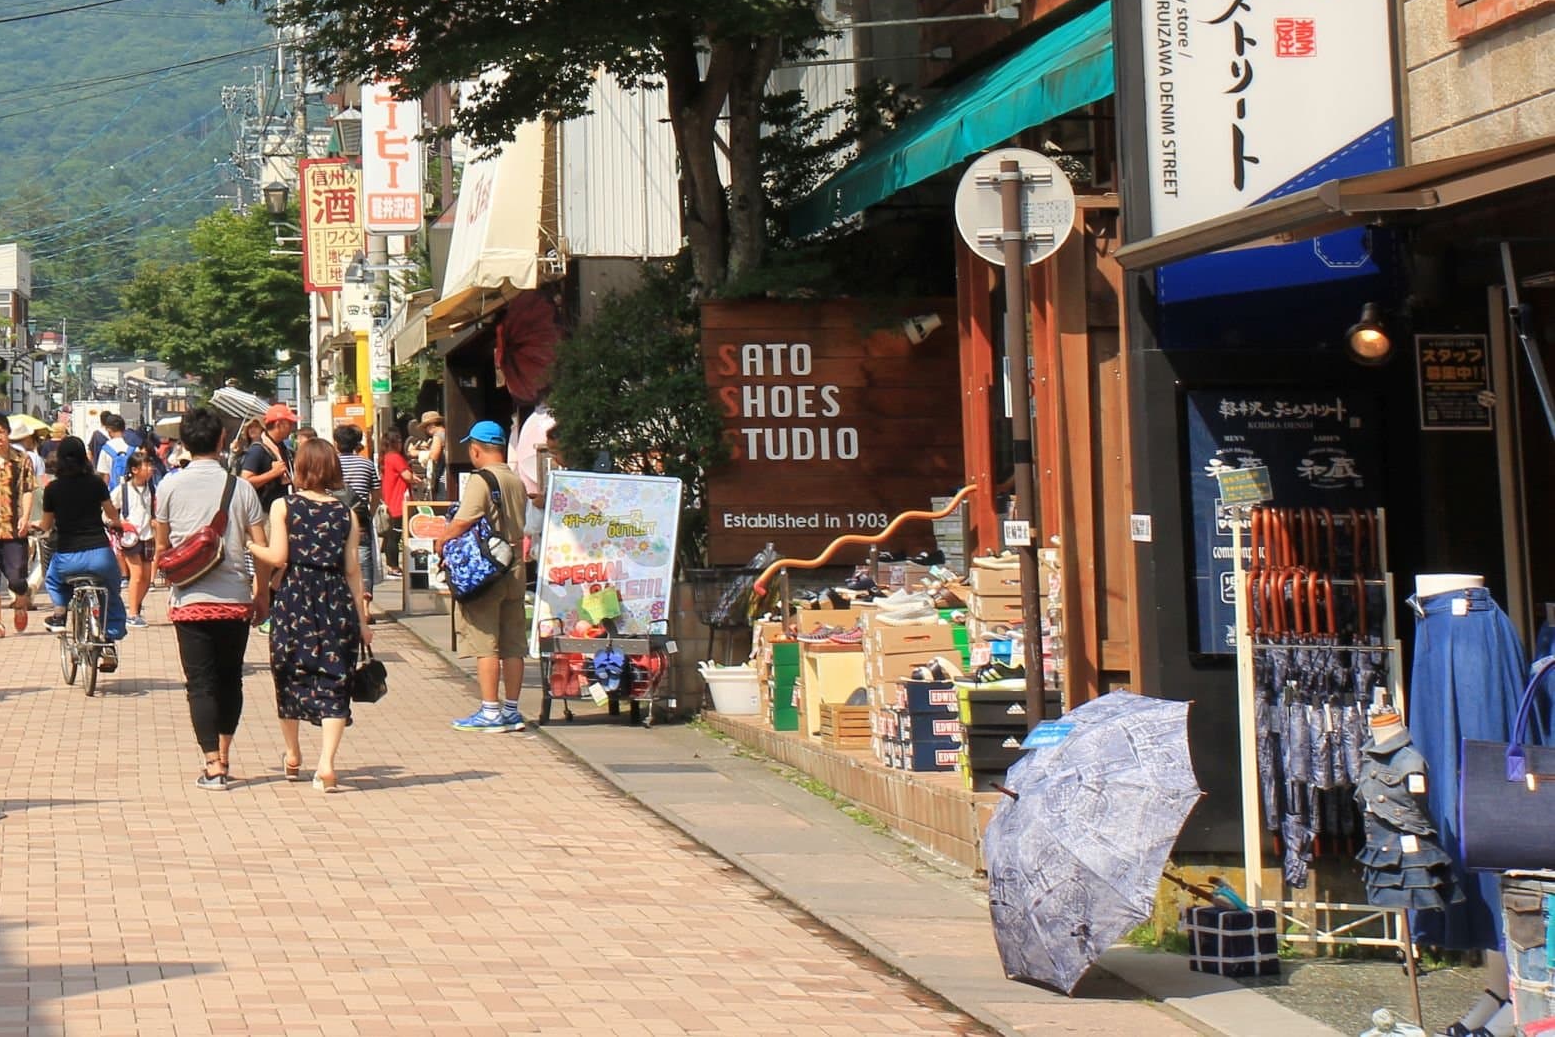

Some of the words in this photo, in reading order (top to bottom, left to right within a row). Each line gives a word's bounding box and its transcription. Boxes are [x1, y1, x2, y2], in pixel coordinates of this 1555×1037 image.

[1176, 7, 1190, 48] store
[1158, 81, 1175, 137] DENIM
[311, 170, 357, 187] 信州の
[1161, 141, 1179, 198] STREET
[312, 187, 357, 225] 酒
[371, 196, 415, 220] 軽井沢店
[327, 230, 360, 244] ワイン
[329, 249, 362, 263] 地ビー
[718, 344, 811, 376] SATO
[1422, 349, 1483, 363] スタッフ
[720, 385, 840, 418] SHOES
[1218, 397, 1271, 421] 軽井沢
[723, 513, 819, 528] Established
[825, 513, 840, 528] in
[847, 513, 888, 528] 1903
[548, 561, 629, 585] SPECIAL
